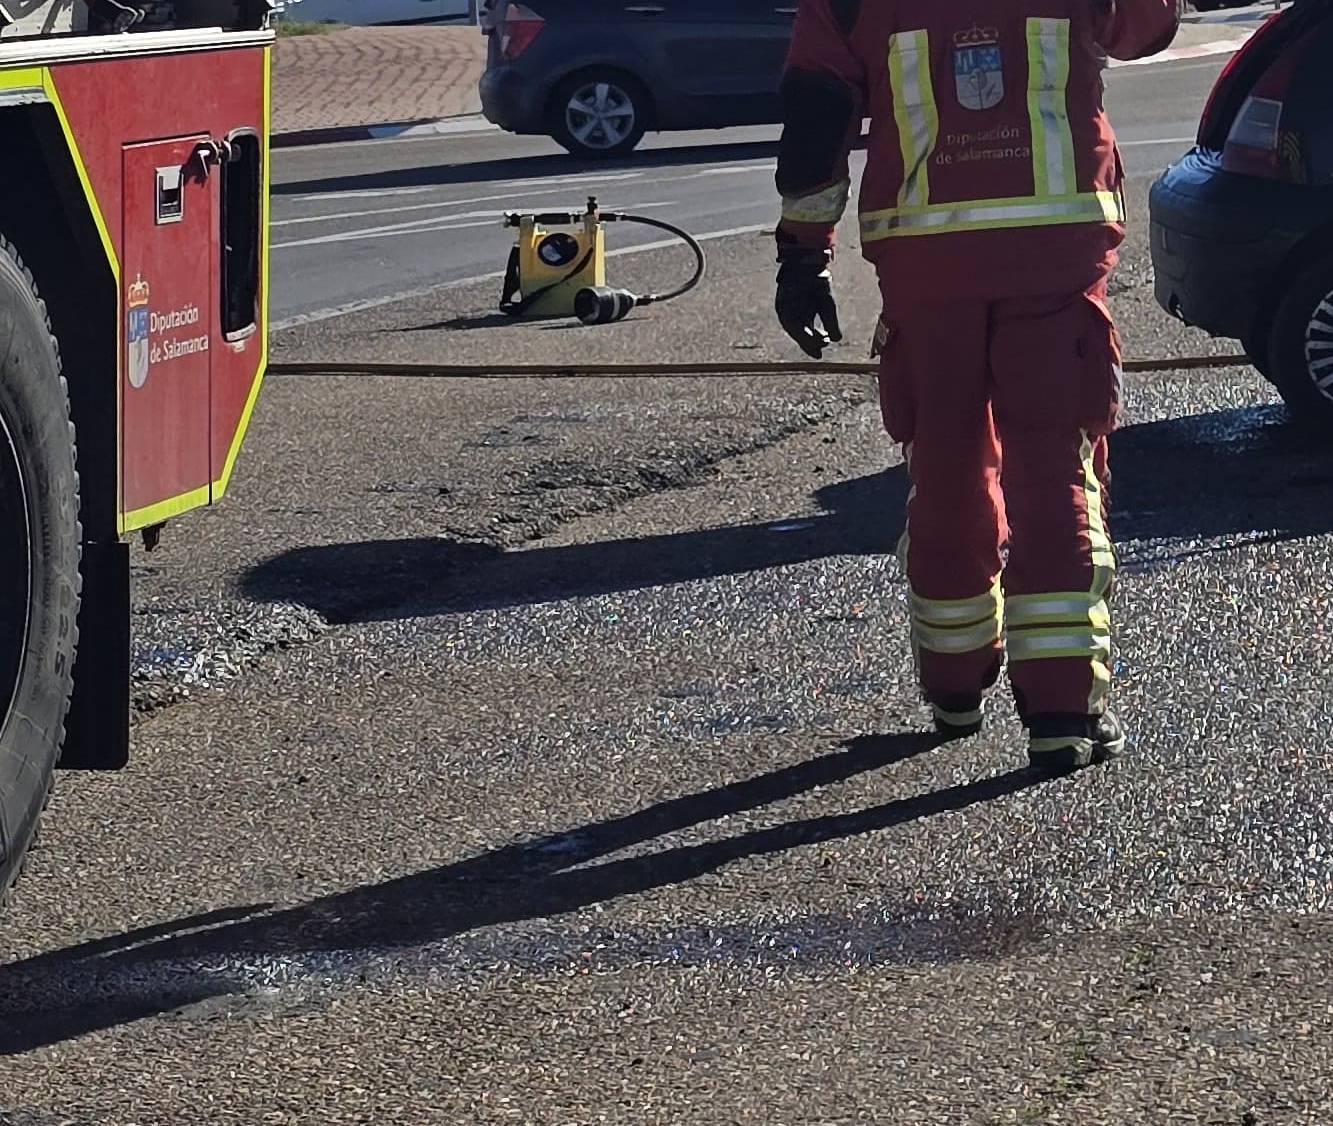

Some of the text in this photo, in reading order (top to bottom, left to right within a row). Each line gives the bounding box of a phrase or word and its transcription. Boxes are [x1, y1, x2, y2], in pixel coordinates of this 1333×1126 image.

[149, 302, 199, 335] Diputación
[149, 334, 209, 364] de Salamanca
